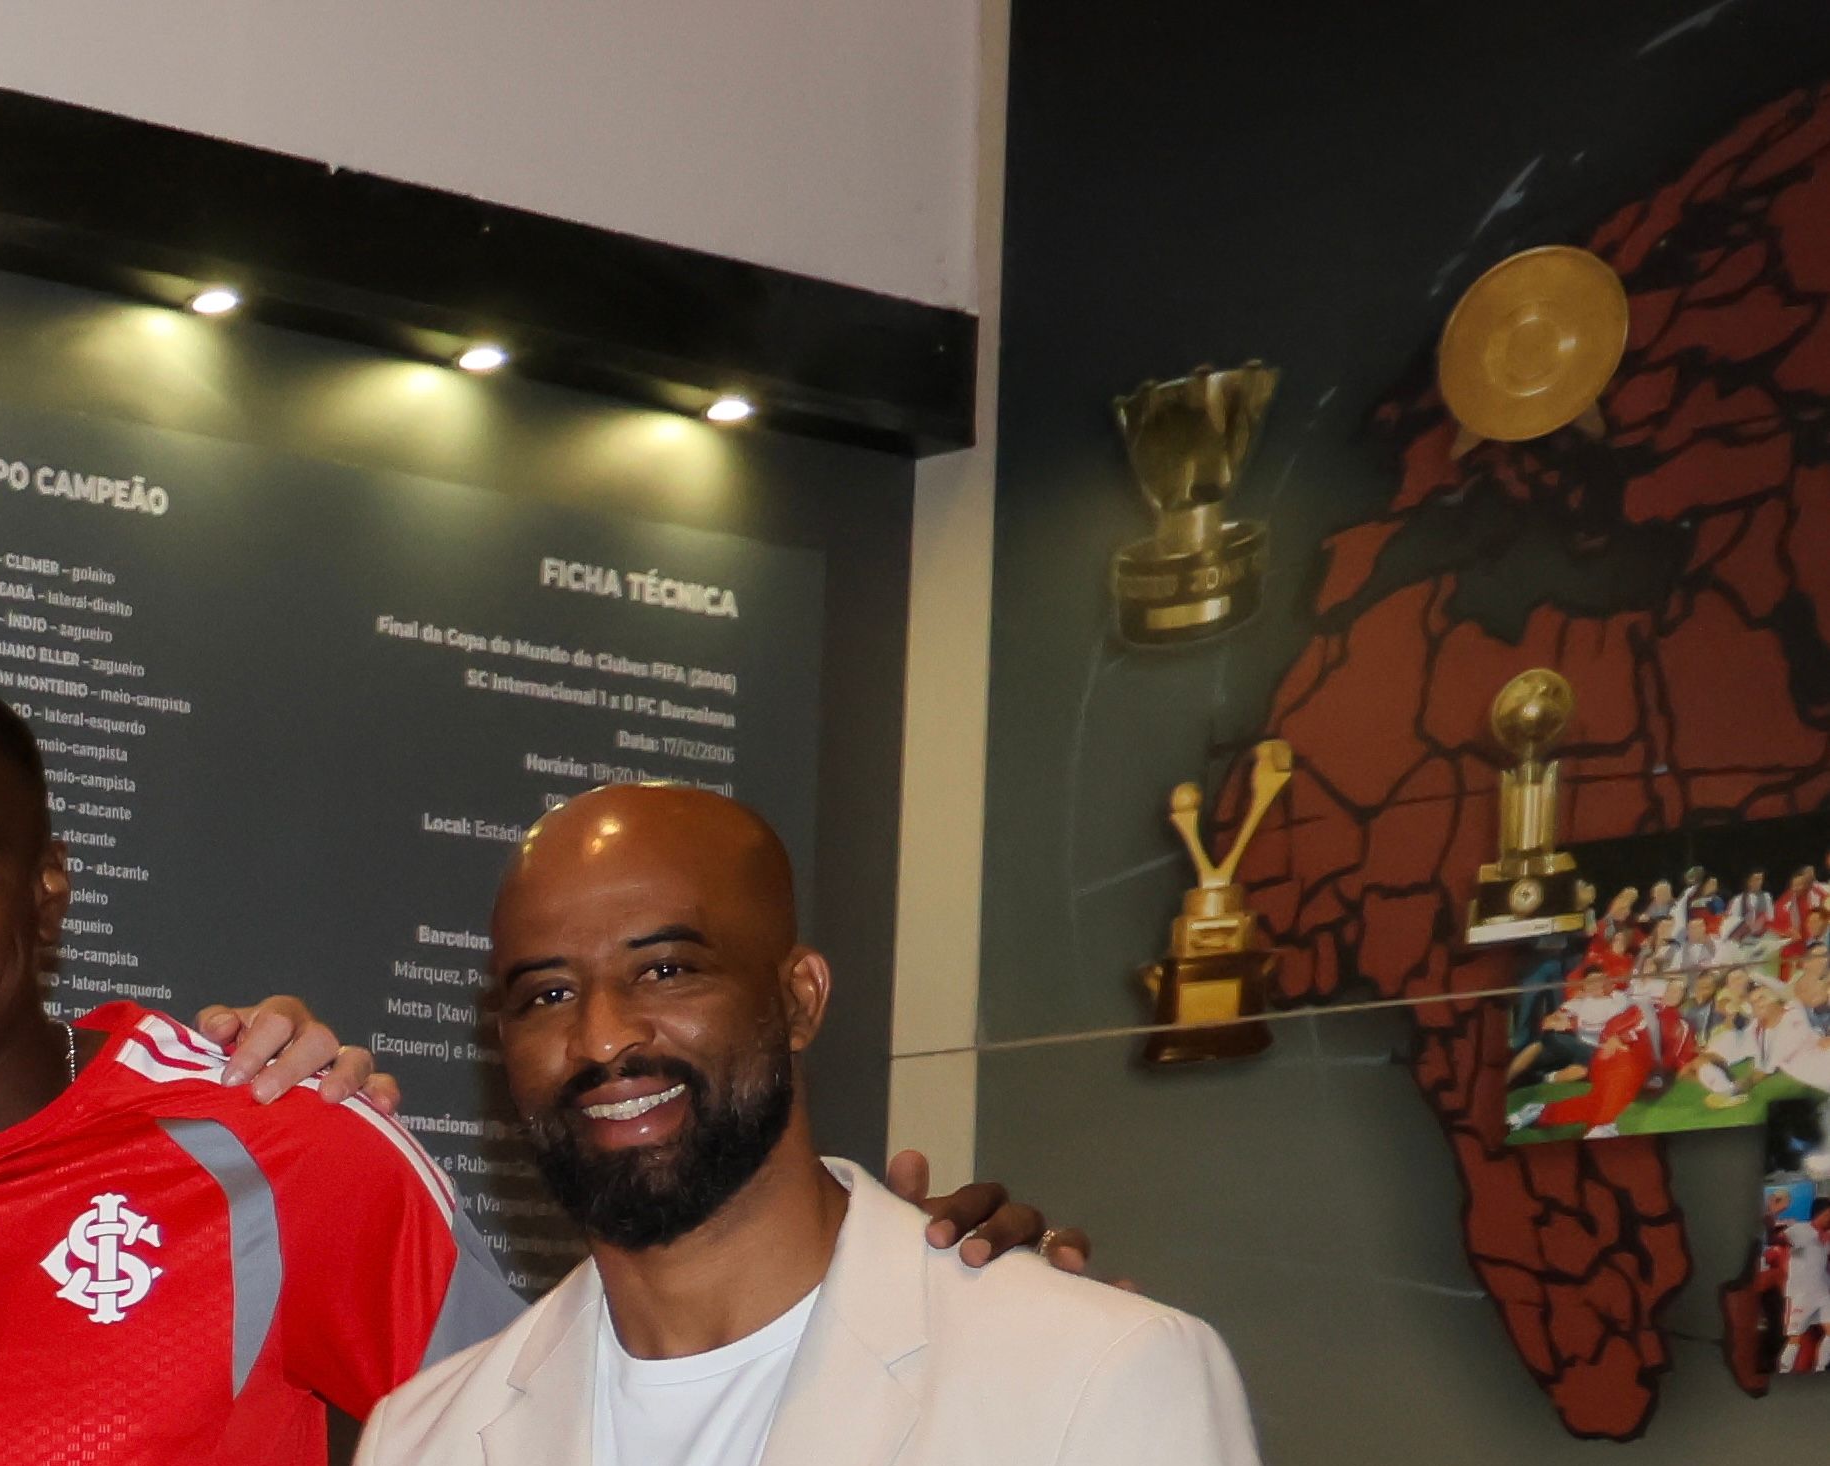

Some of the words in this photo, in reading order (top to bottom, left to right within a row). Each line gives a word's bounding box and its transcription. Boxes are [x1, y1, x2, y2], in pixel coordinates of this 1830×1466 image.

[36, 467, 169, 516] CAMPEÃO
[540, 557, 621, 598] FICHA
[627, 568, 738, 618] TÉCNICA
[377, 615, 418, 639] Final
[445, 629, 487, 652] Copa
[515, 640, 570, 663] Mundo
[17, 675, 88, 697] MONTEIRO
[466, 668, 488, 688] SC
[491, 672, 597, 705] Internacional
[45, 709, 145, 735] lateral-esquerdo
[524, 753, 587, 778] Horário:
[78, 803, 132, 820] atacante
[423, 812, 471, 836] Local:
[62, 831, 116, 847] atacante
[96, 863, 149, 881] atacante
[394, 960, 465, 986] Márquez,
[388, 998, 432, 1018] Motta
[371, 1033, 450, 1062] (Ezquerro)
[454, 1046, 463, 1059] e
